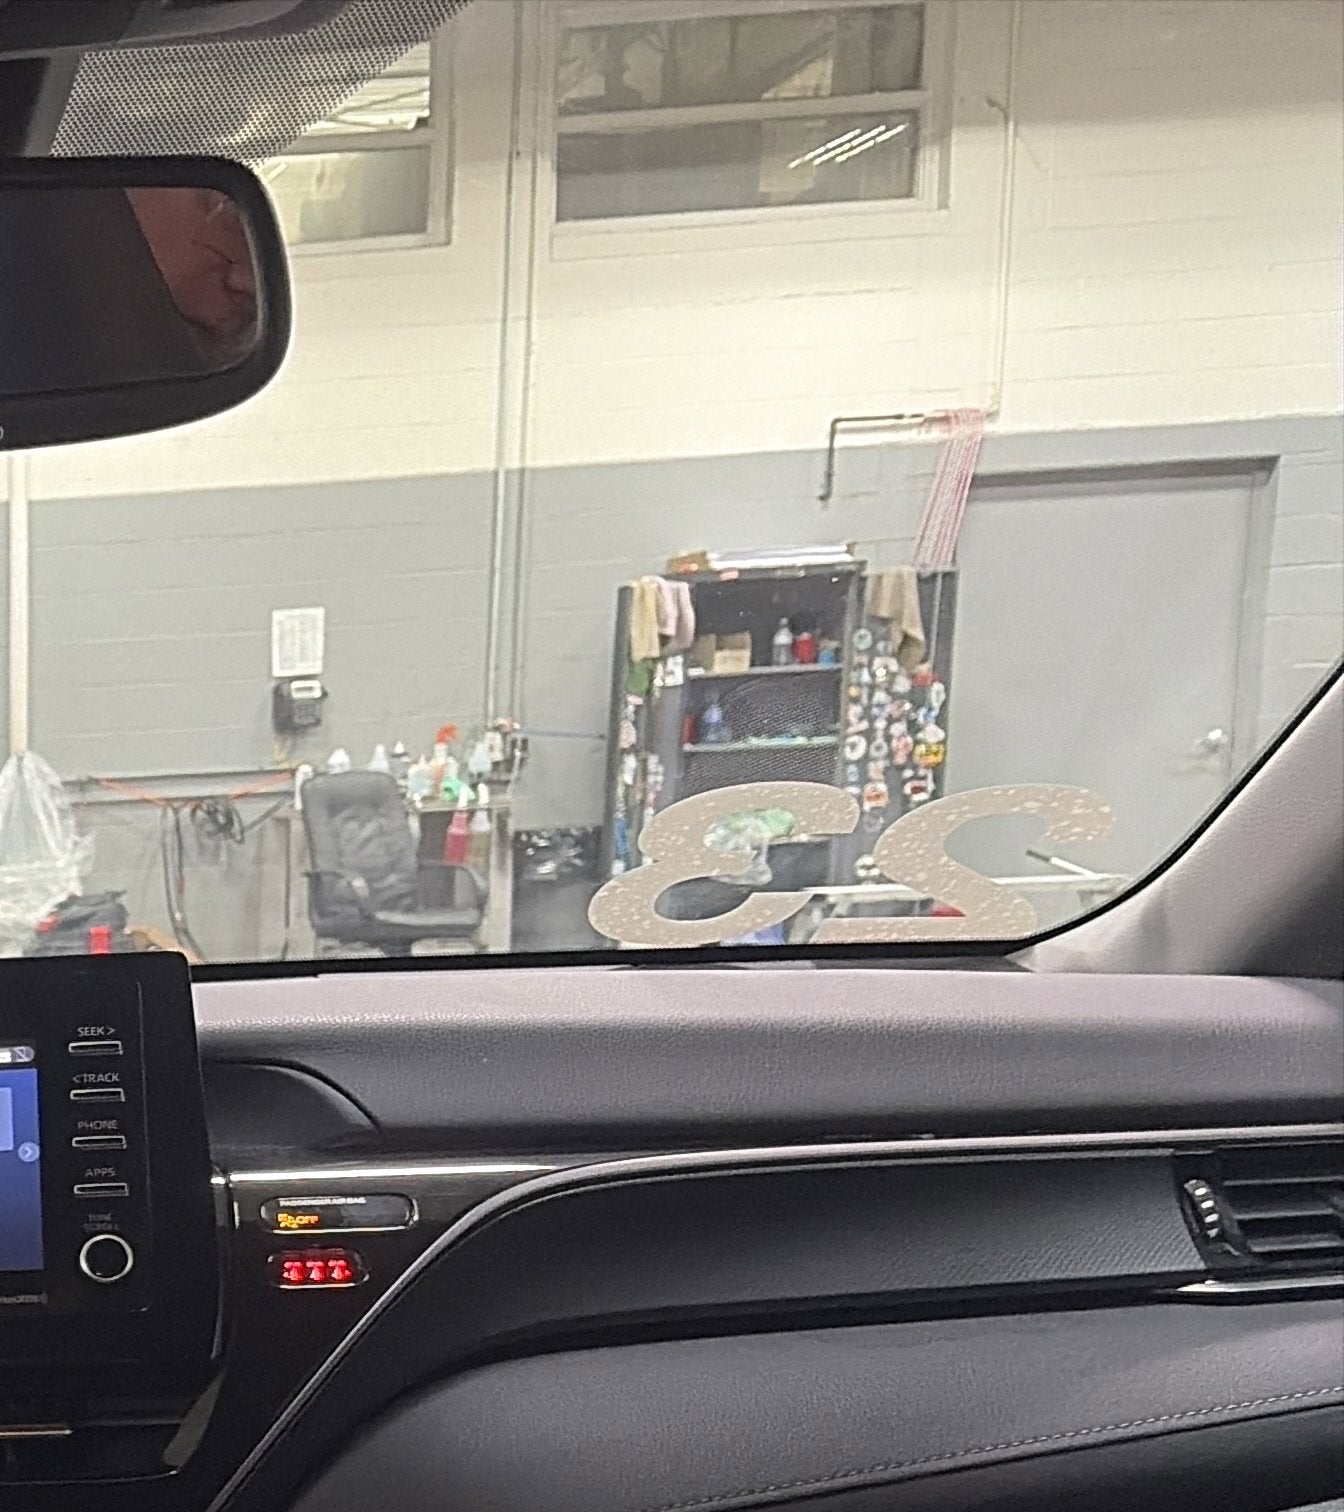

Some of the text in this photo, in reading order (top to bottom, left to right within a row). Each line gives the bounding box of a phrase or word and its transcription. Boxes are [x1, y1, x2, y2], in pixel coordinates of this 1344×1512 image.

[77, 1026, 104, 1036] SEEK
[83, 1073, 120, 1083] TRACK
[77, 1120, 118, 1130] PHONE
[84, 1167, 116, 1177] APPS
